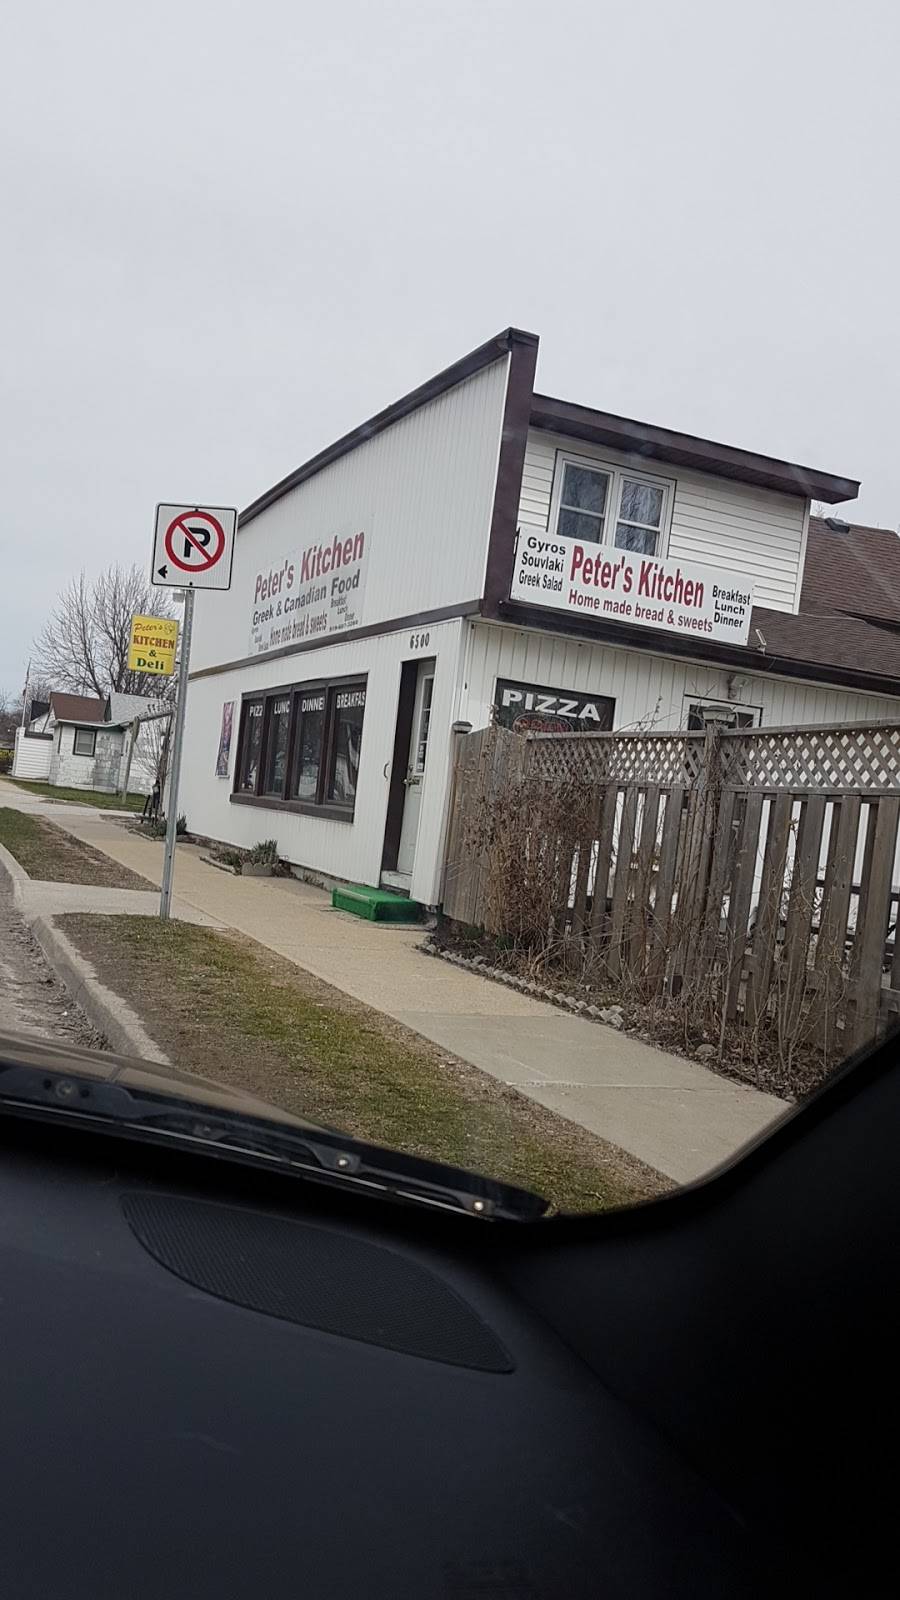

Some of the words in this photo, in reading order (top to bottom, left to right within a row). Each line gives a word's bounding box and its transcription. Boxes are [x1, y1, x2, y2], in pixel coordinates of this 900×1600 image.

[527, 537, 566, 555] Gyros
[254, 560, 295, 604] Peter's
[300, 531, 365, 584] Kitchen
[521, 551, 564, 572] Souvlaki
[519, 569, 541, 588] Greek
[542, 574, 563, 591] Salad
[570, 545, 633, 593] Peter's
[638, 560, 705, 608] Kitchen
[252, 604, 274, 626] Greek
[284, 585, 327, 614] Canadian
[331, 568, 360, 596] Food
[712, 585, 751, 605] Breakfast
[569, 589, 600, 609] Home
[603, 600, 632, 615] made
[635, 602, 664, 622] bread
[667, 609, 675, 626] &
[678, 615, 713, 632] sweets
[714, 600, 745, 615] Lunch
[134, 623, 163, 633] Peter's
[714, 612, 743, 628] Dinner
[133, 634, 175, 649] KITCHEN
[410, 633, 430, 649] 6500
[148, 649, 157, 658] &
[136, 657, 165, 670] Deli
[273, 700, 290, 715] LUNC
[301, 696, 325, 712] DINNE
[336, 691, 366, 709] BREAKFAS
[502, 689, 601, 722] PIZZA
[249, 705, 264, 717] PIZZ
